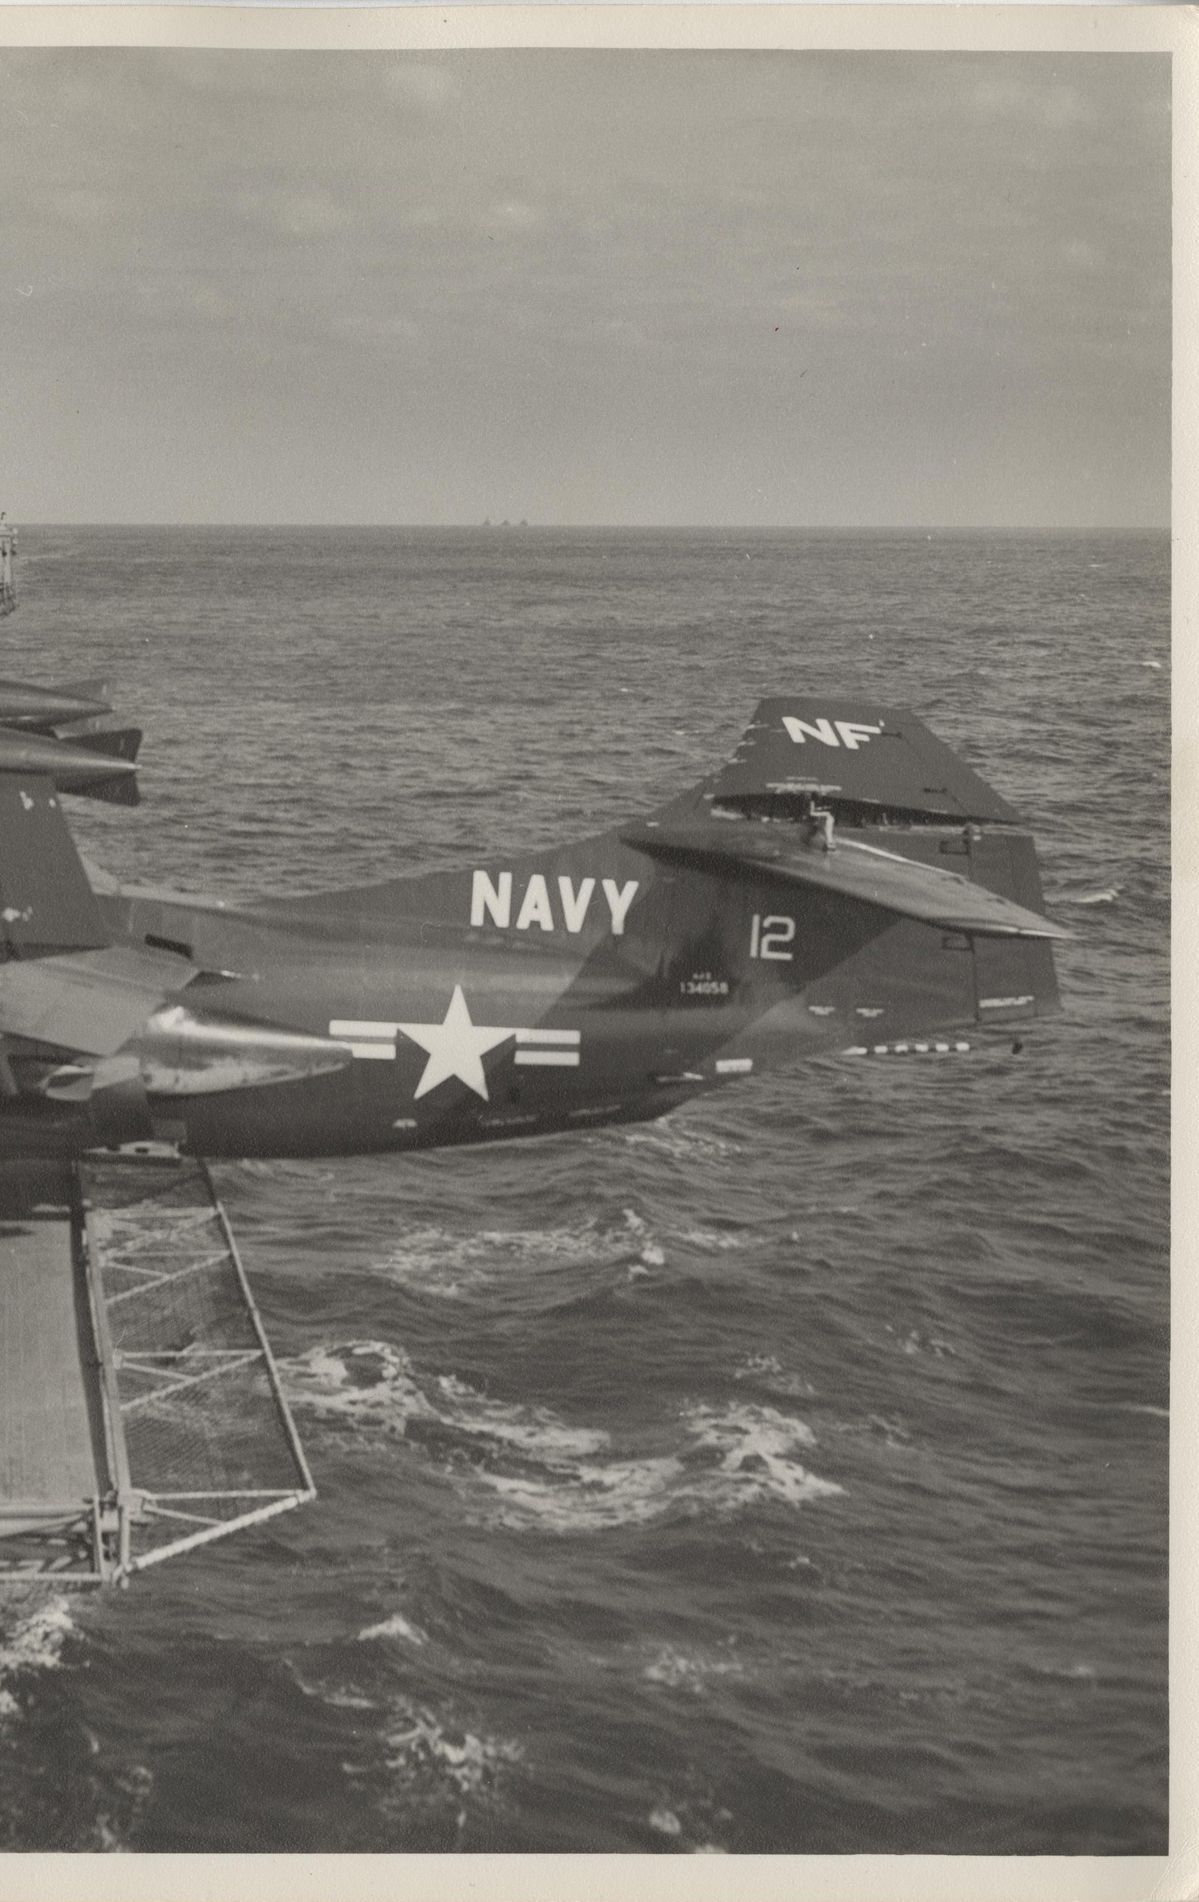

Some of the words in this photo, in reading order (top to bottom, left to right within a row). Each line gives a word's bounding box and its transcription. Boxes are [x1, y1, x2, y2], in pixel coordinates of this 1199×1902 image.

[781, 716, 882, 750] NF
[470, 870, 640, 935] NAVY
[749, 913, 797, 961] 12
